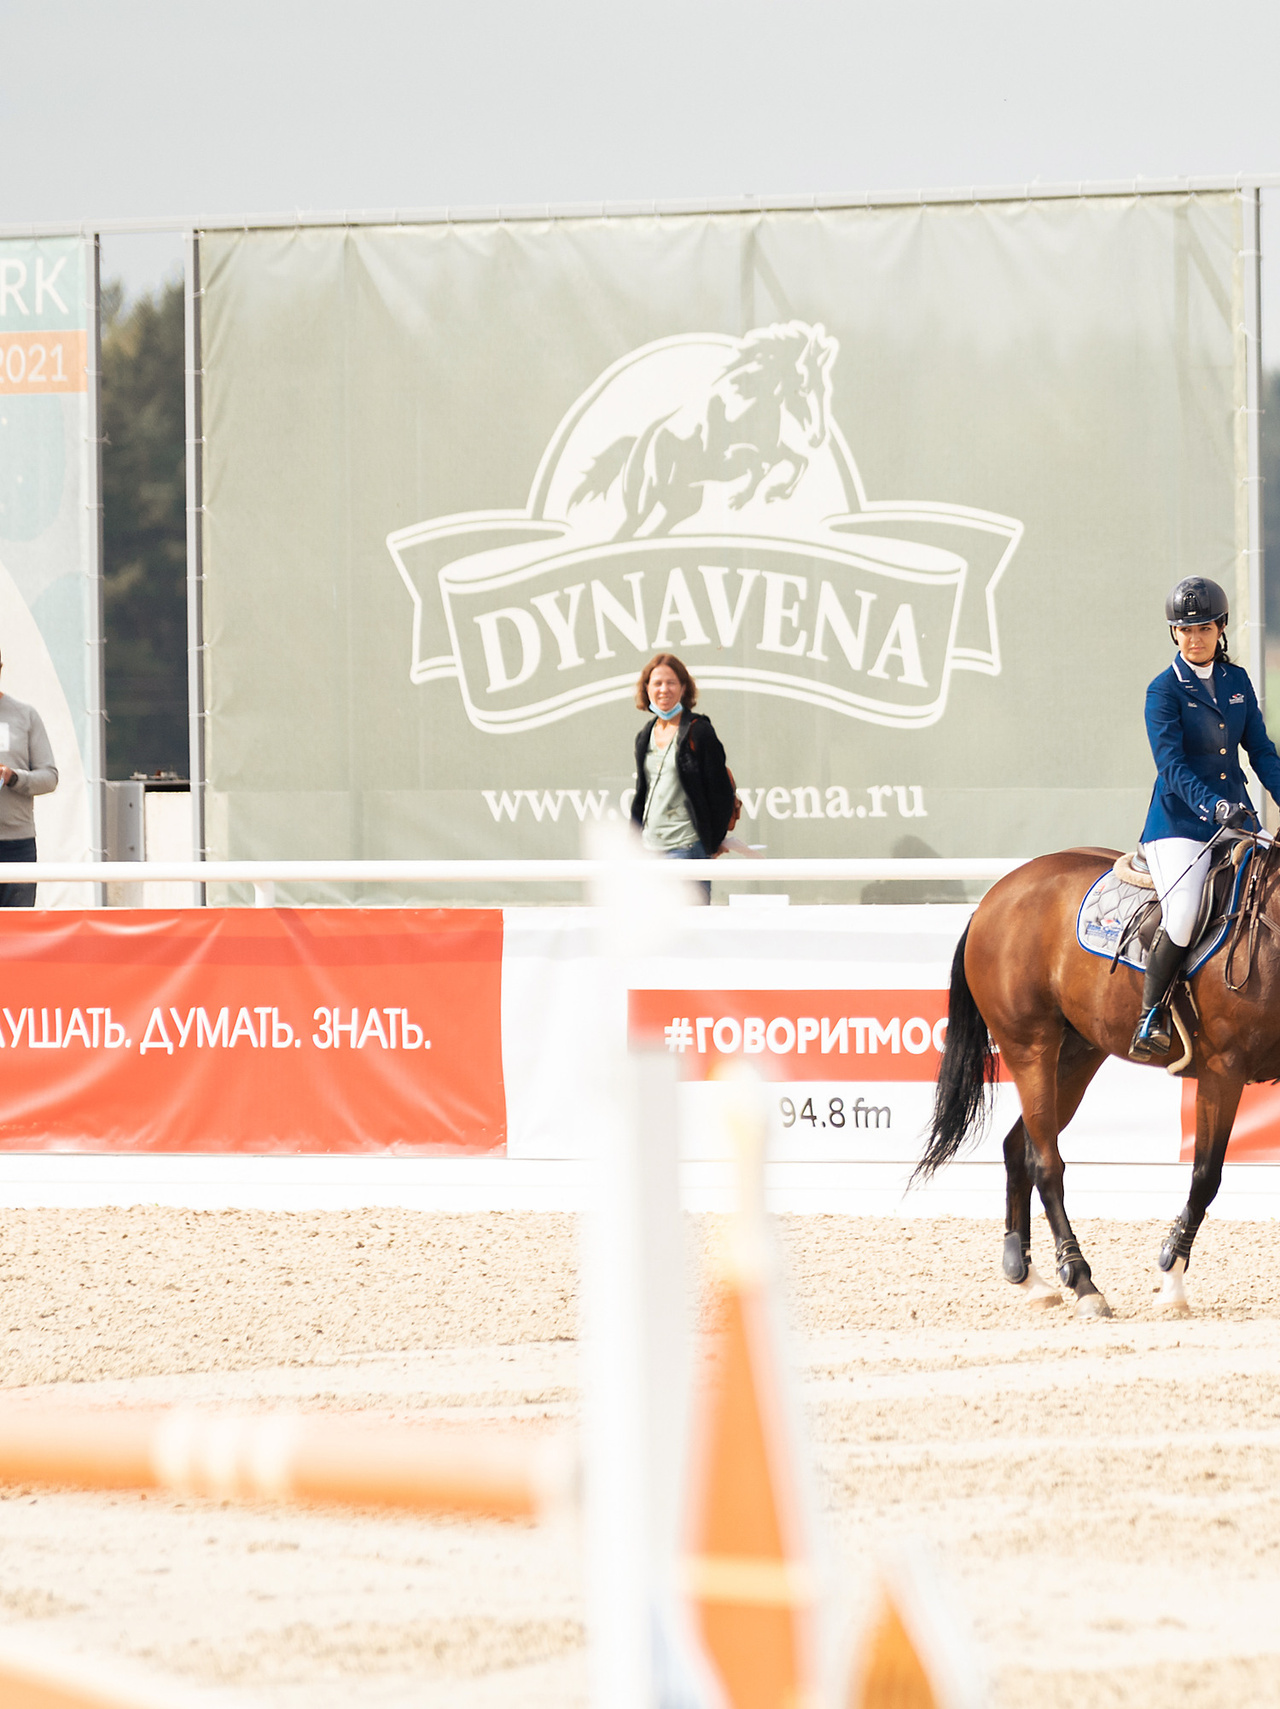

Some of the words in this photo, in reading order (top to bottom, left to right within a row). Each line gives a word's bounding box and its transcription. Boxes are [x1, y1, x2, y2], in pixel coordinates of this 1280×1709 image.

[0, 343, 69, 385] 021
[473, 565, 930, 694] DYNAVENA
[0, 1007, 132, 1049] УШАТЬ.
[139, 1006, 301, 1056] ДУМАТЬ.
[311, 1007, 432, 1050] ЗНАТЬ.
[779, 1096, 847, 1129] 94.8
[852, 1096, 892, 1129] fm
